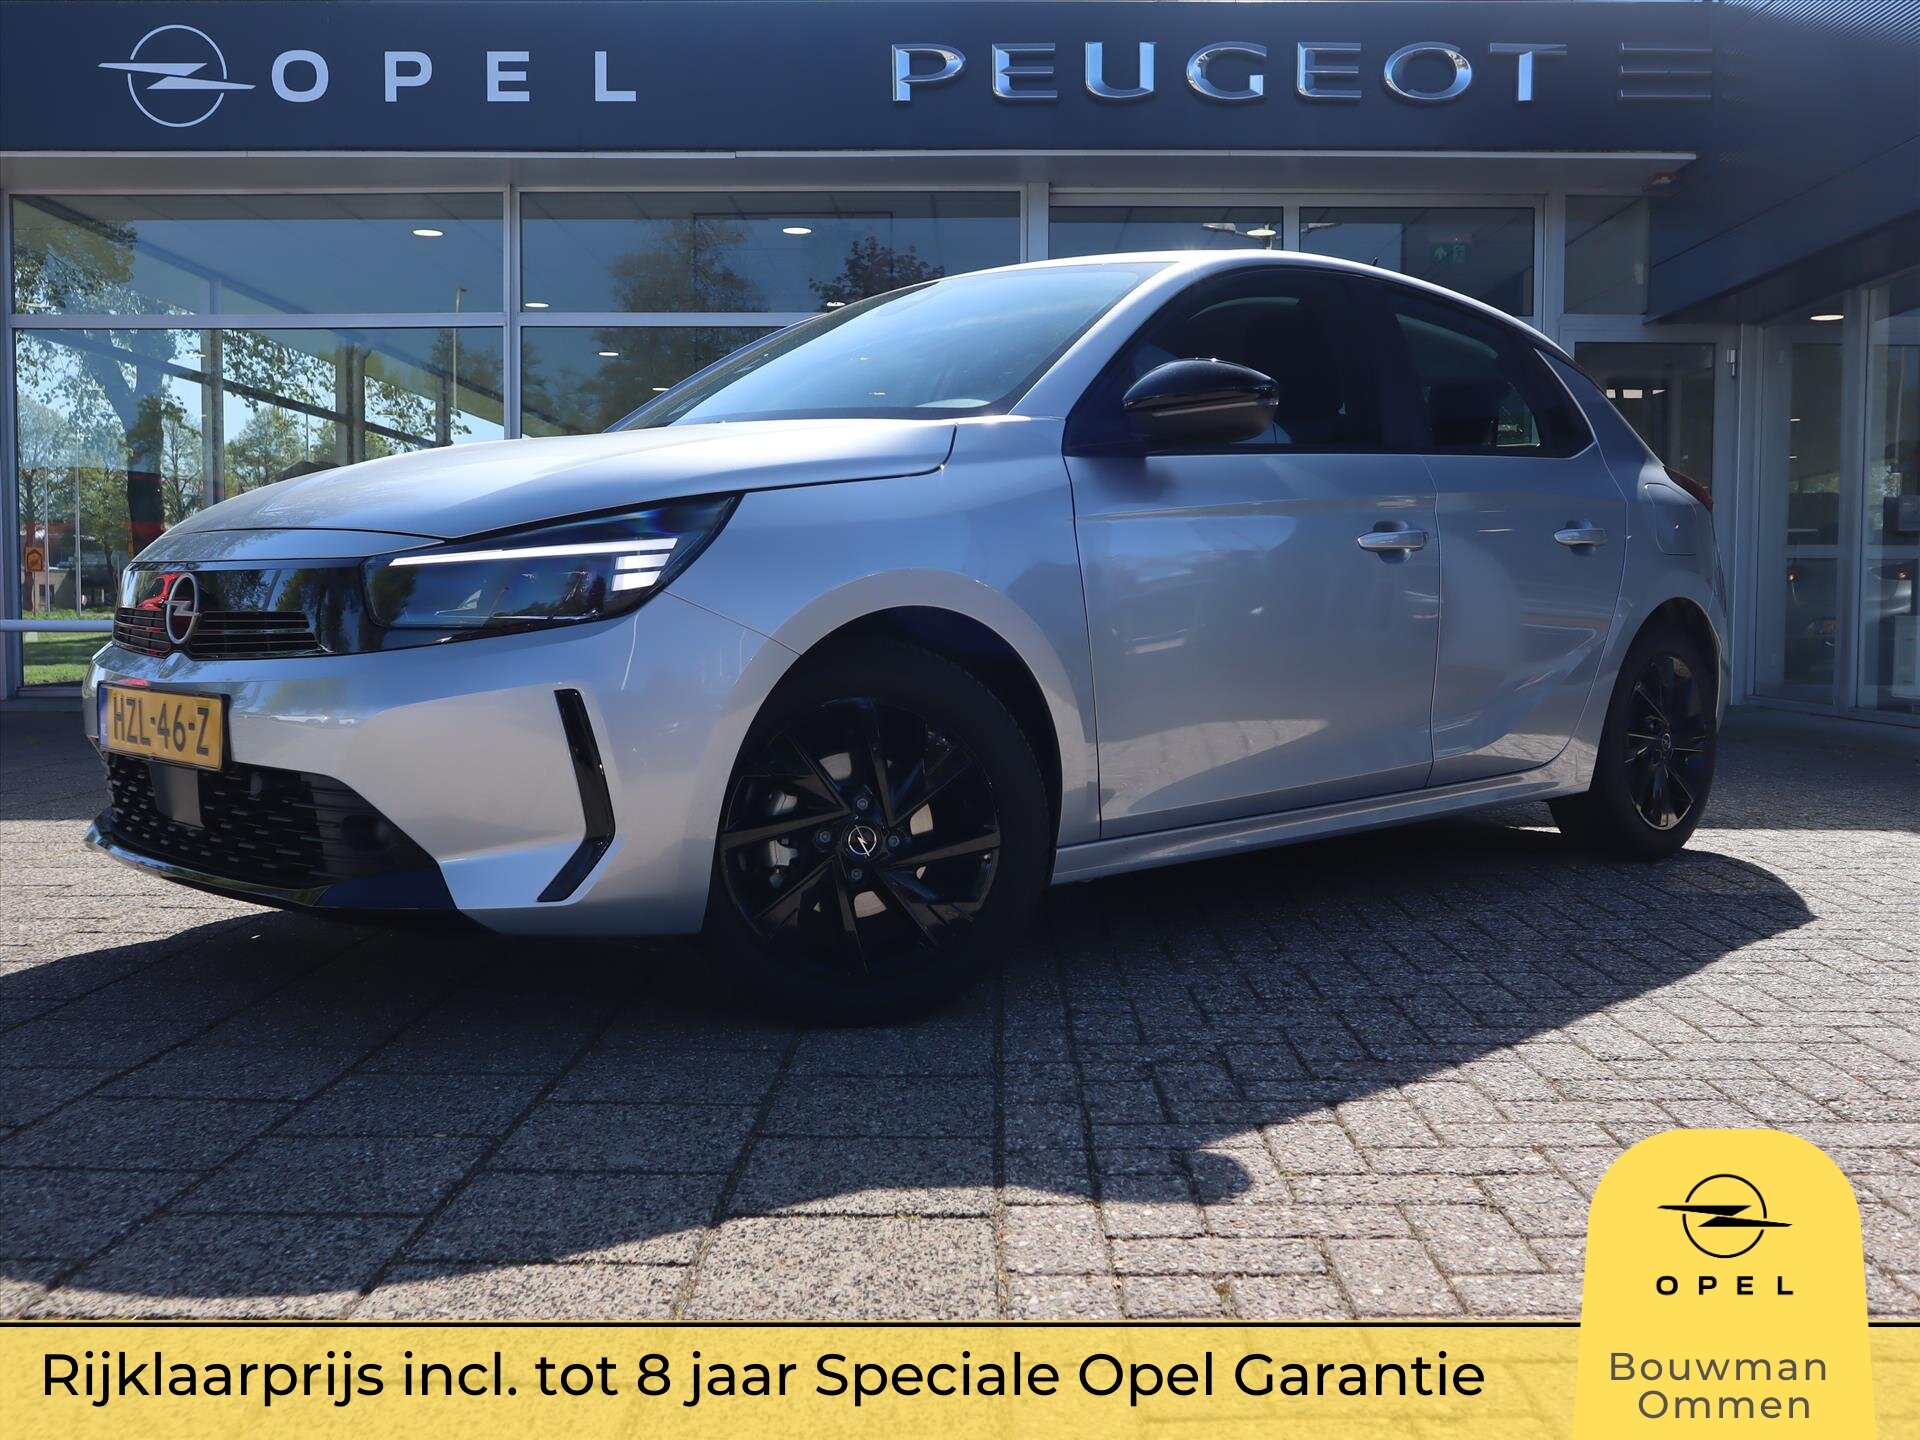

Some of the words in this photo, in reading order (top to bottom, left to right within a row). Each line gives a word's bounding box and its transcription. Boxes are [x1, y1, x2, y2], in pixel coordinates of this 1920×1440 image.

[272, 50, 637, 103] OPEL
[891, 42, 1568, 103] PEUGEOT
[112, 695, 210, 756] HZL-46-Z
